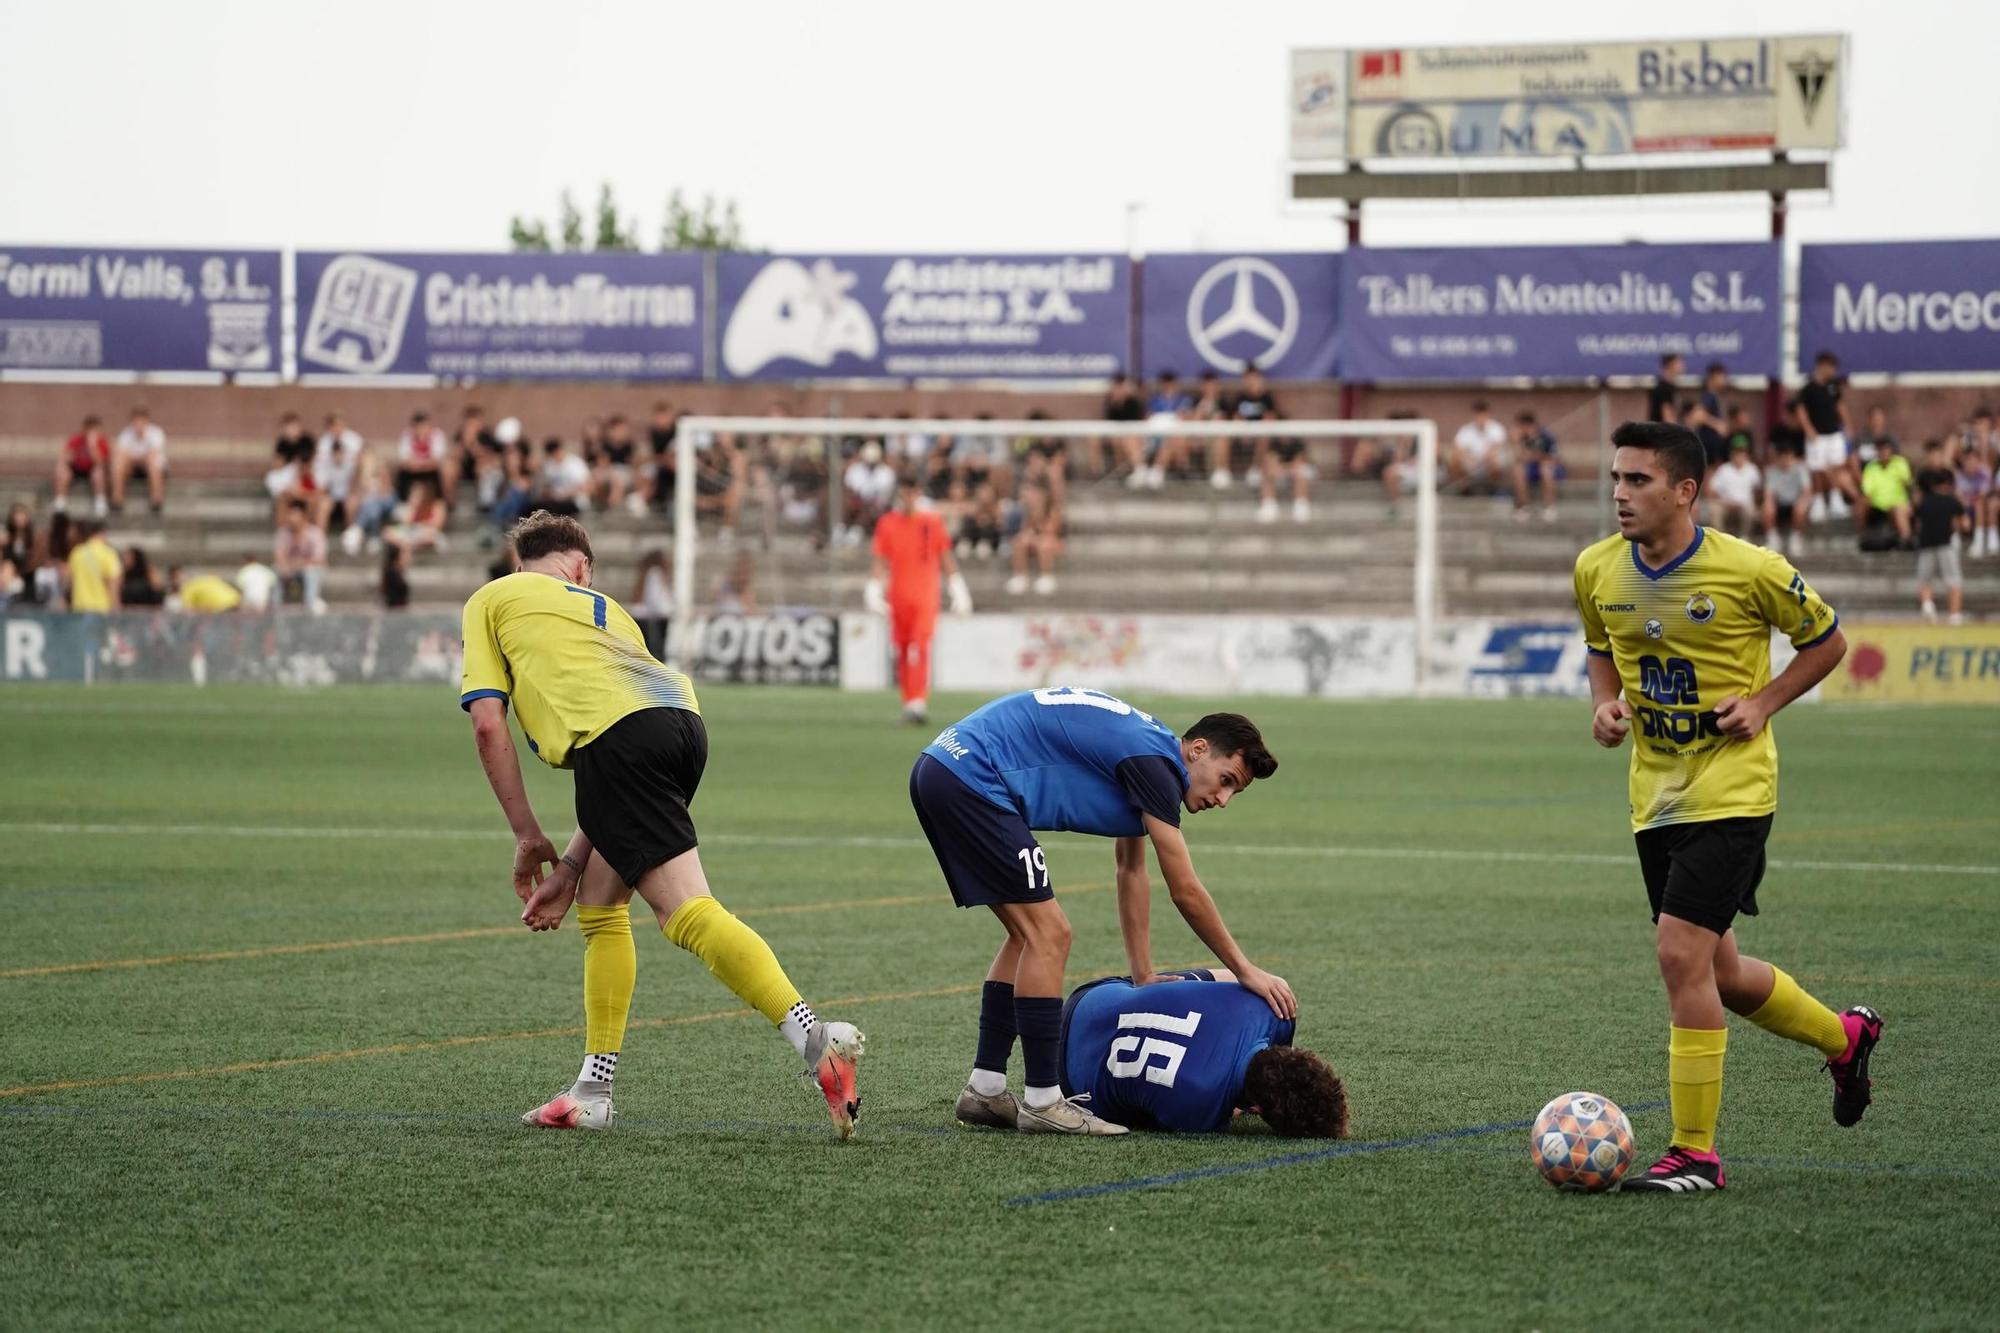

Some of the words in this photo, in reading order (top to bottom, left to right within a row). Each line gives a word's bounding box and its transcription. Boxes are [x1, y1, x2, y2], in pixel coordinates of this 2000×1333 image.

[1638, 40, 1769, 89] Bisbal
[883, 258, 1113, 293] Assistencial
[1359, 274, 1489, 316] Tallers
[1495, 271, 1685, 318] Montoliu,
[564, 585, 608, 630] 7
[1604, 603, 1636, 612] PATRICK
[1018, 846, 1049, 889] 19
[1106, 1010, 1202, 1089] 15
